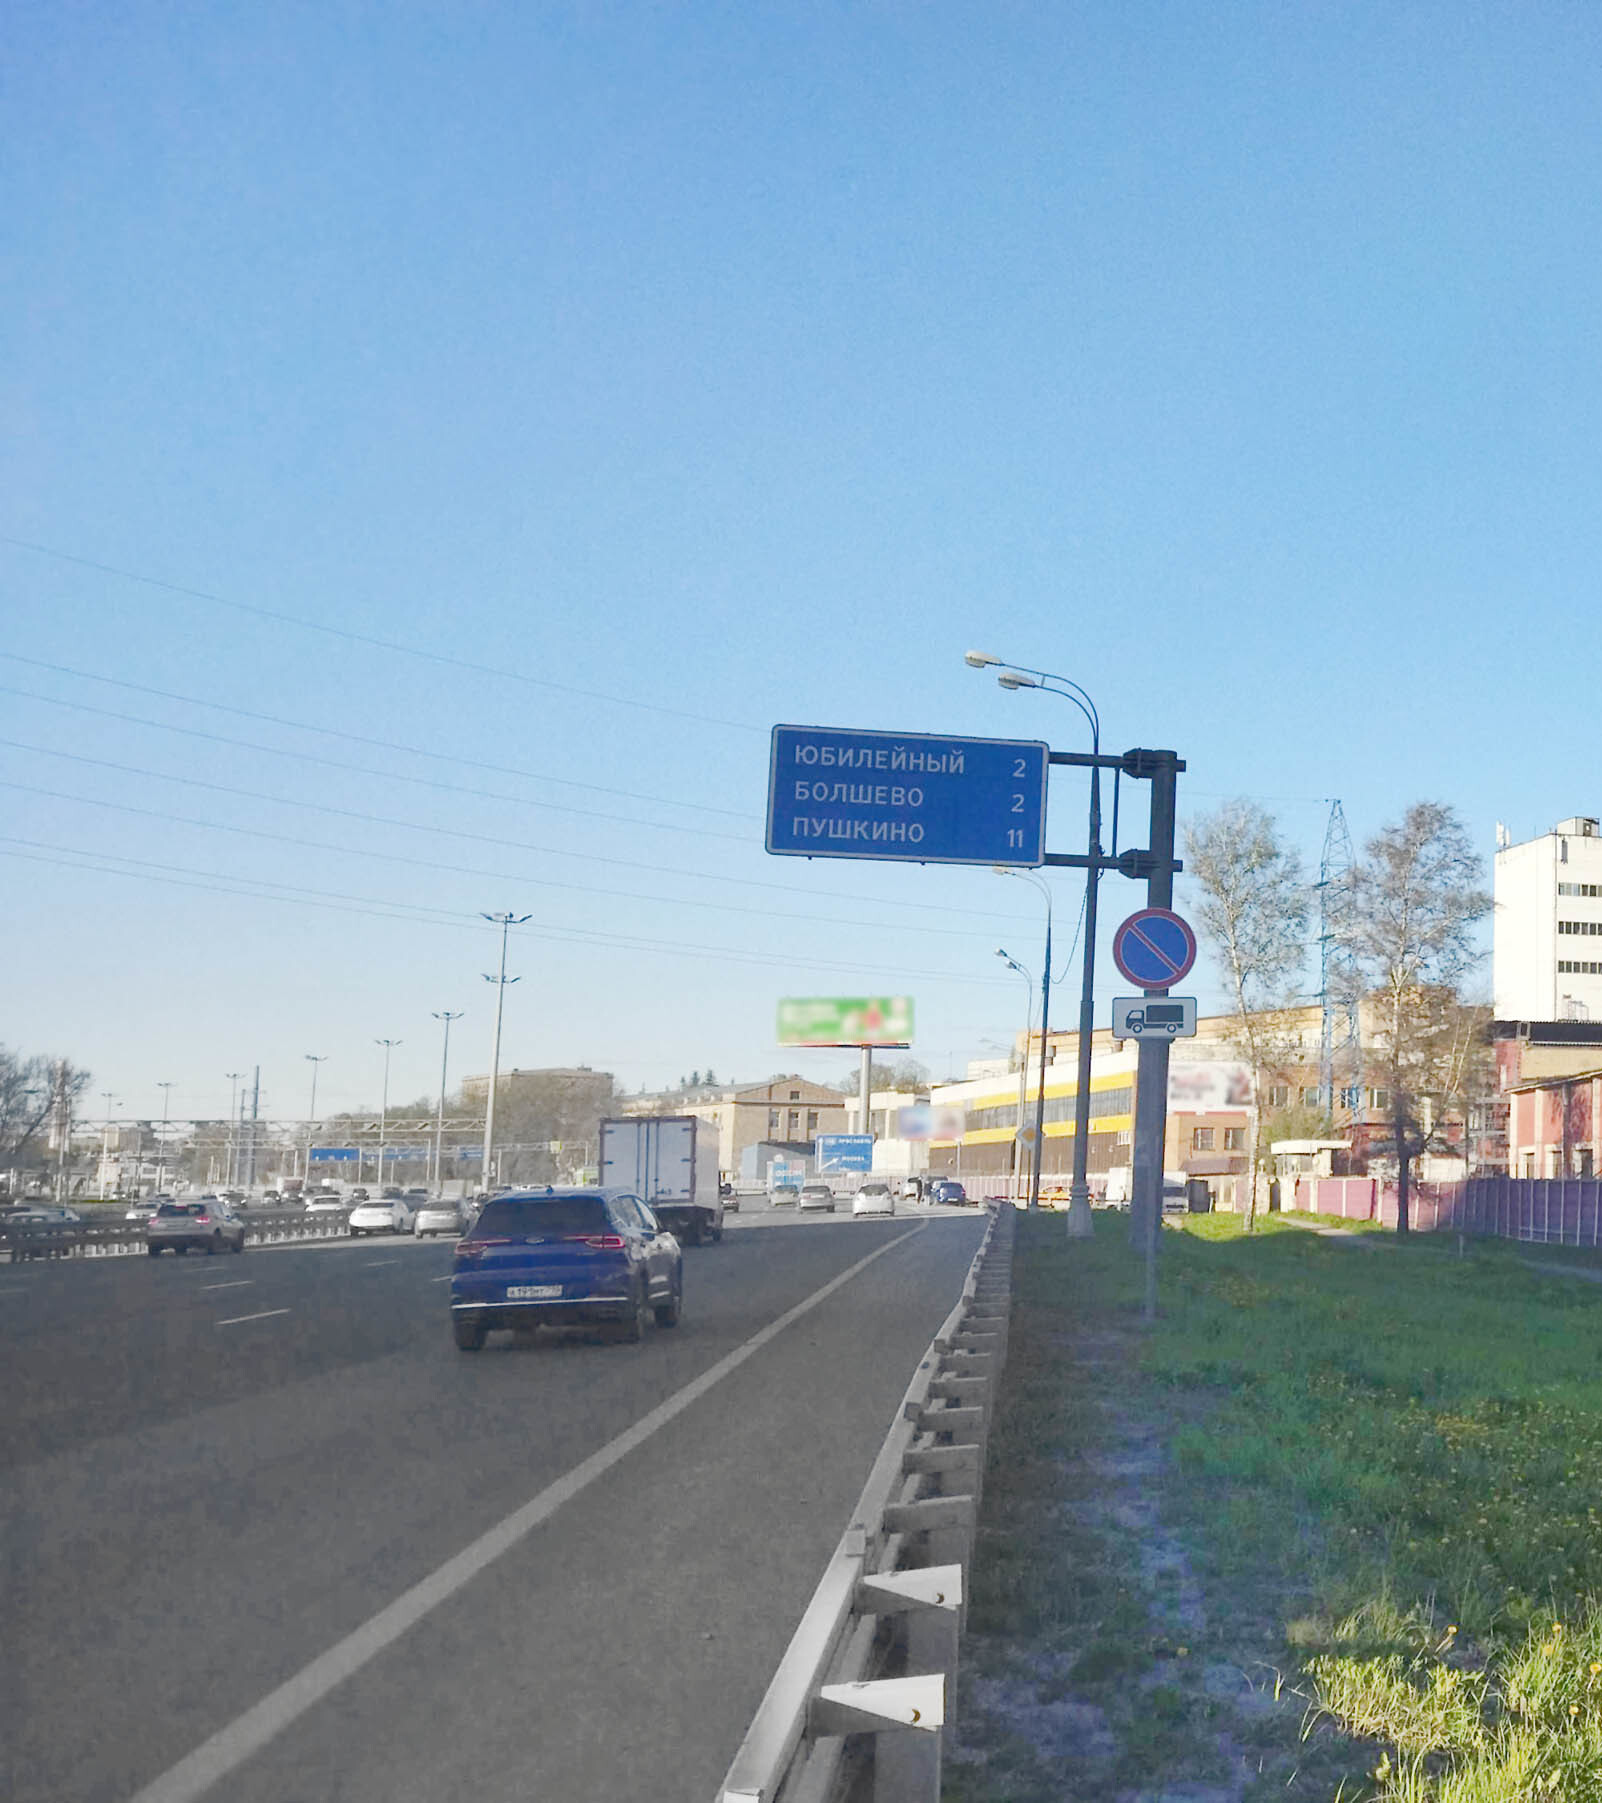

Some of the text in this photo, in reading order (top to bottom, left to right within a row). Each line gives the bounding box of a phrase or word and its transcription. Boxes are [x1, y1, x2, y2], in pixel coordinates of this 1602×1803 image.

[795, 744, 1027, 778] ЮБИЛЕЙНЫЙ 2
[795, 781, 1025, 813] БОЛШЕВО 2
[792, 816, 1024, 849] ПУШКИНО 11
